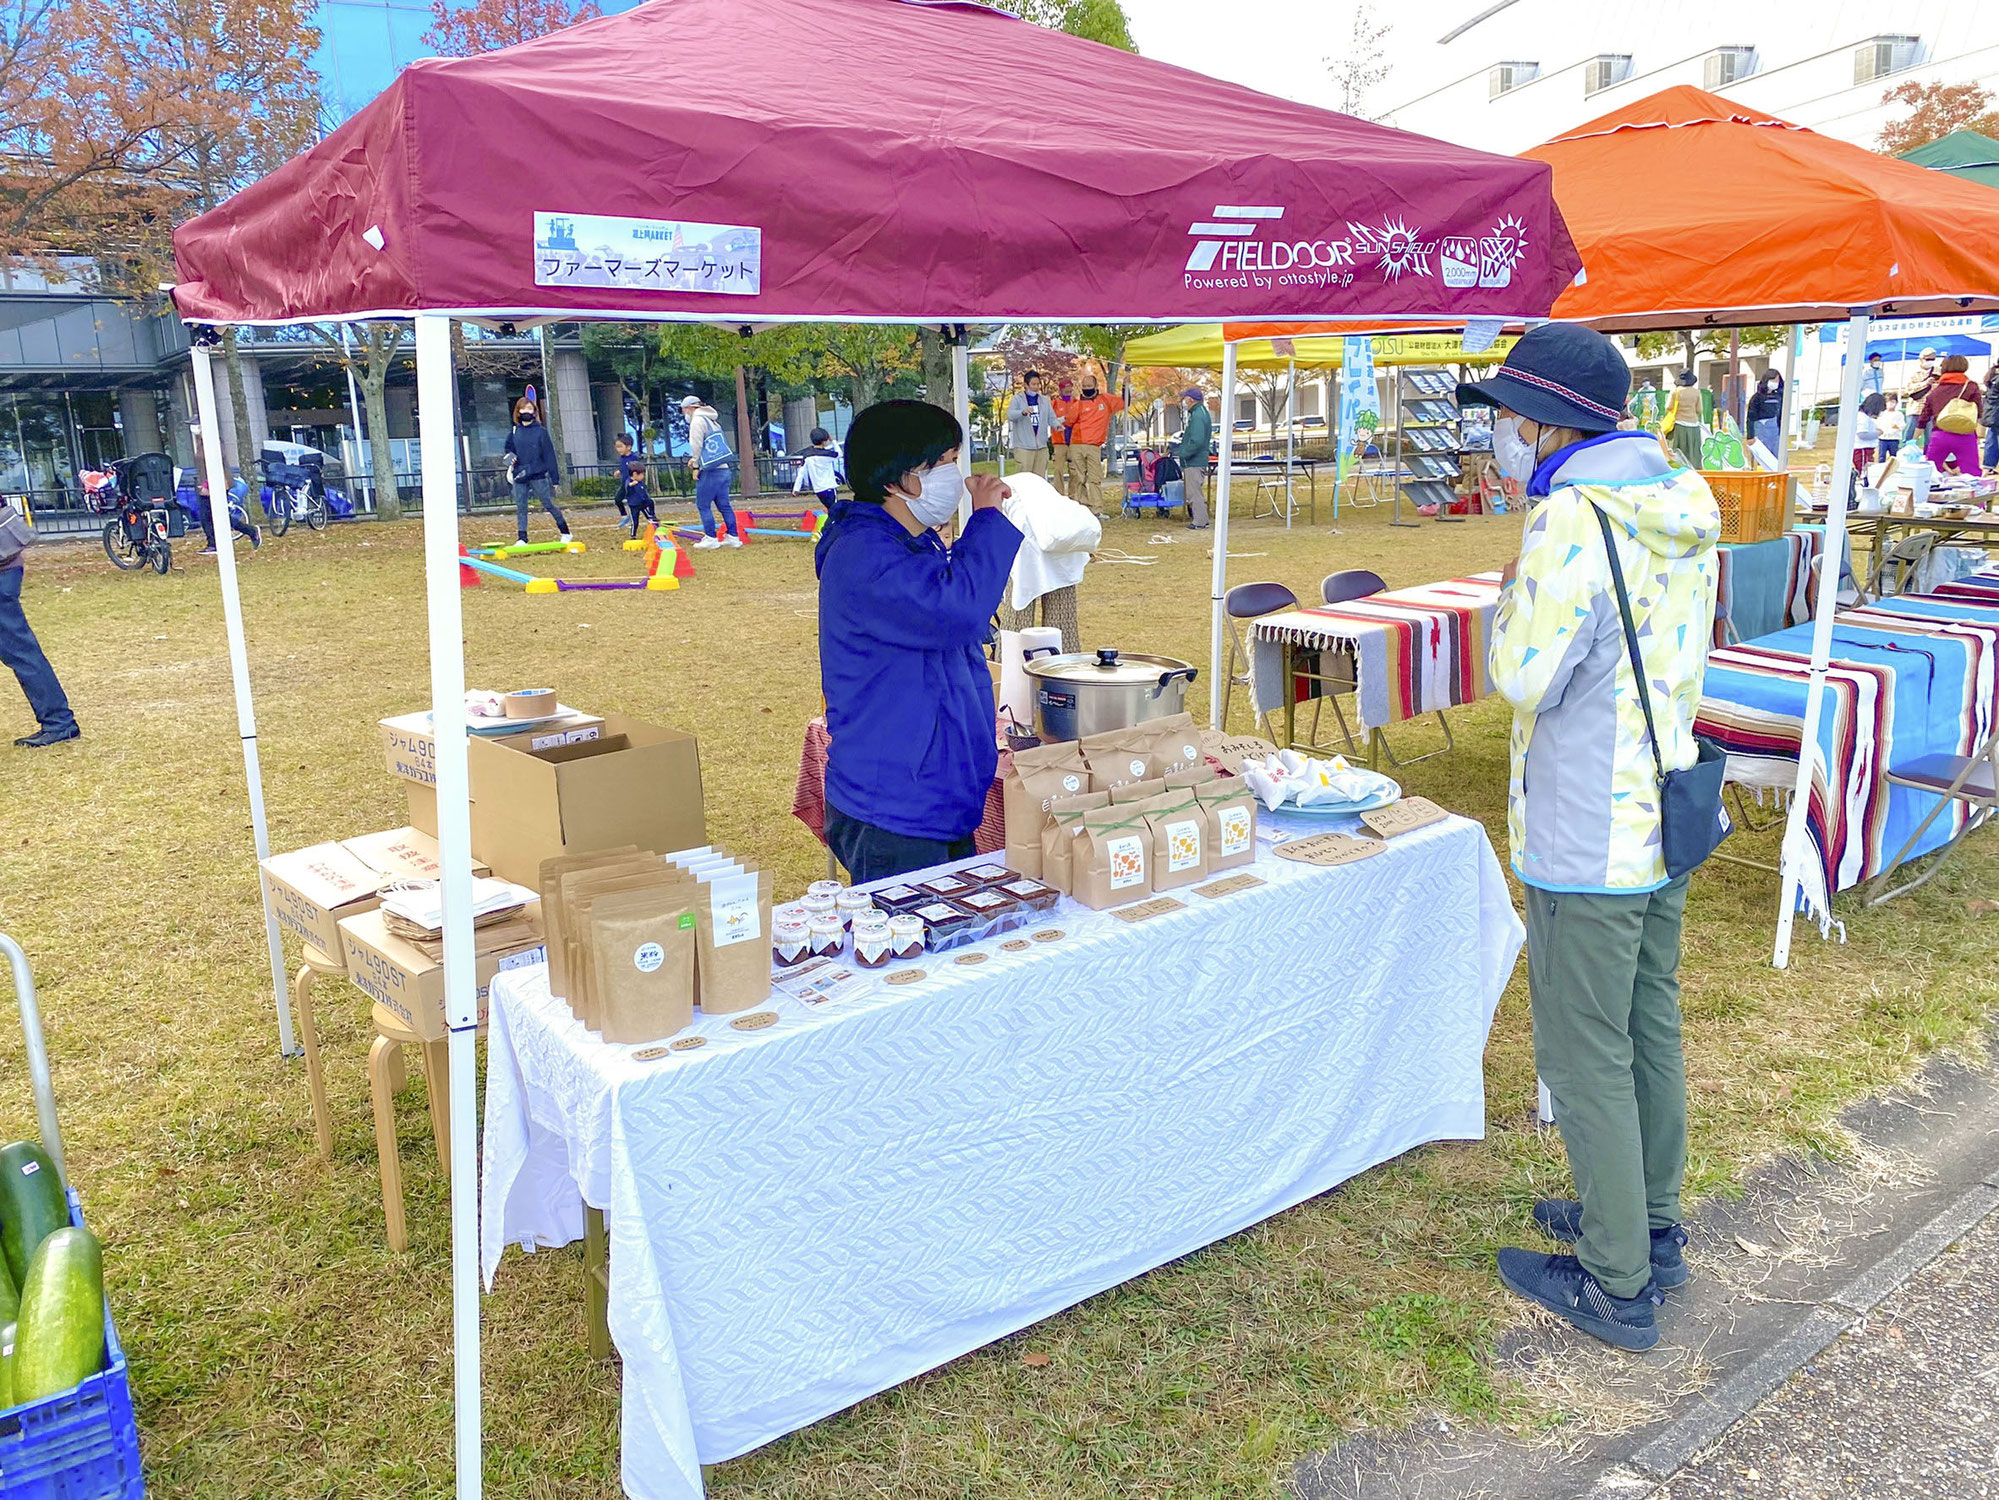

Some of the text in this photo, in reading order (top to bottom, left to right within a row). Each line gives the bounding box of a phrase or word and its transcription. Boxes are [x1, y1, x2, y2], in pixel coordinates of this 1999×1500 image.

[543, 257, 753, 280] ファーマーズマーケット
[1184, 267, 1354, 290] Powered by ottostyle.jp
